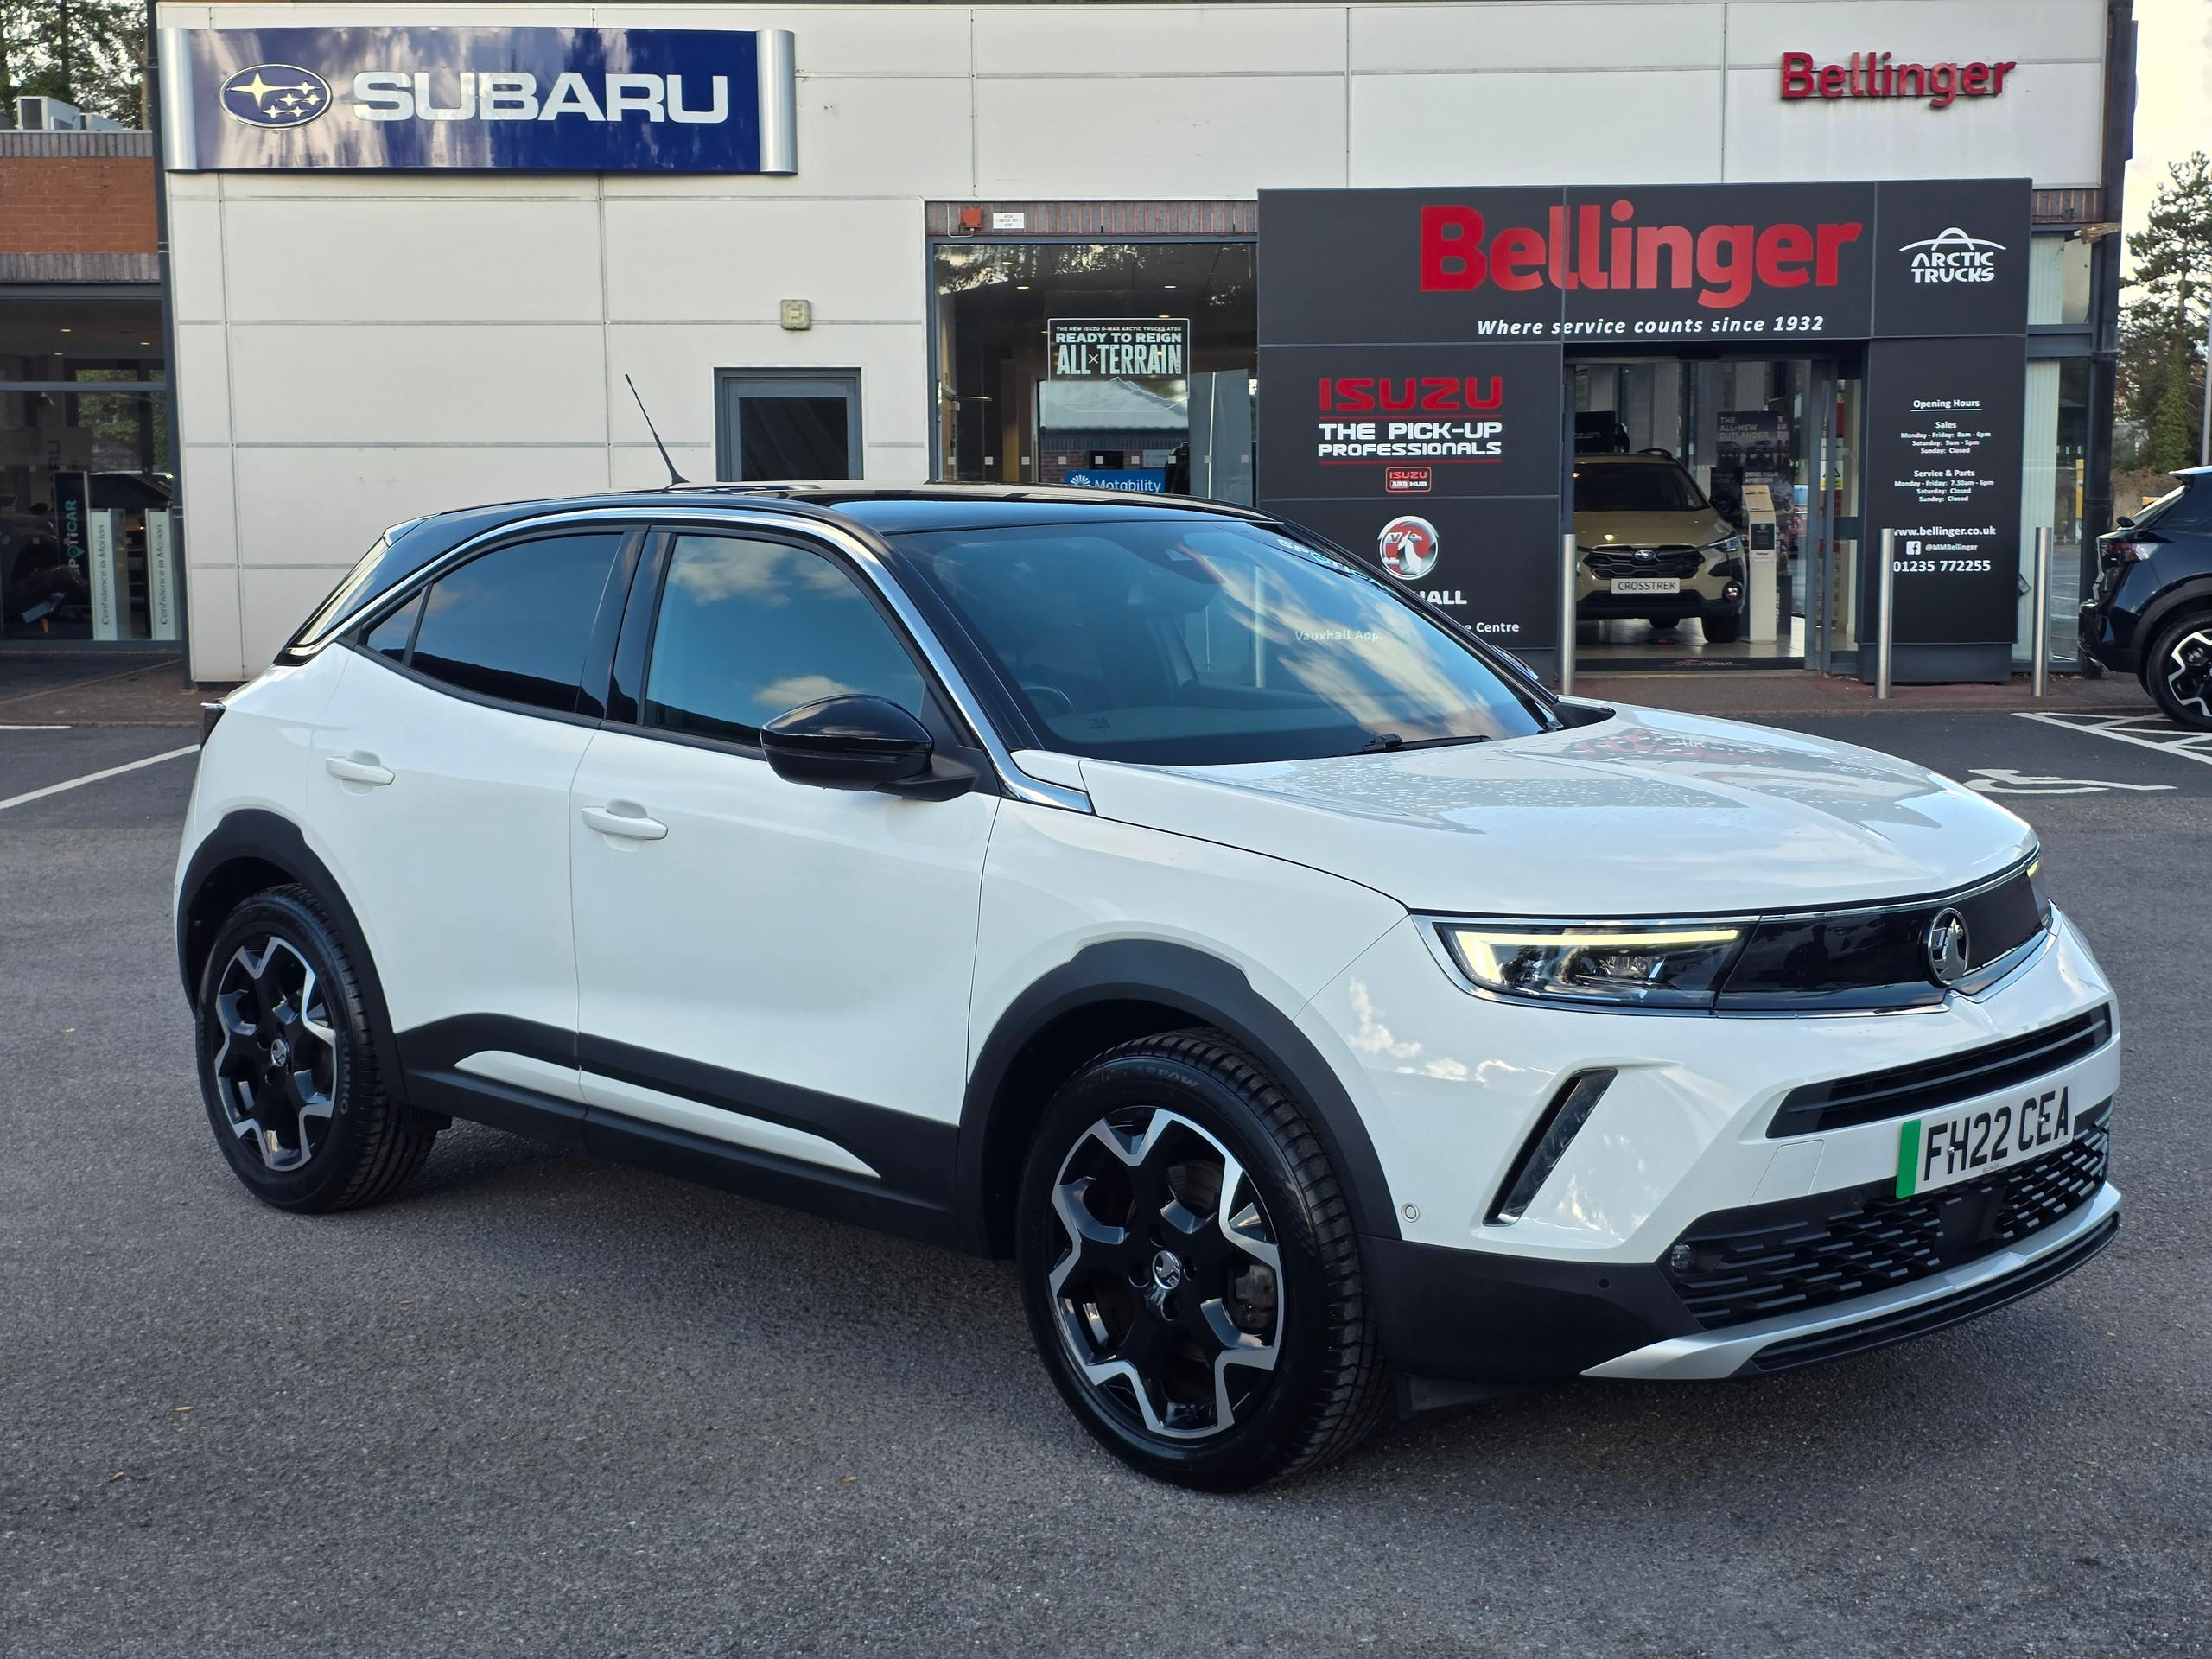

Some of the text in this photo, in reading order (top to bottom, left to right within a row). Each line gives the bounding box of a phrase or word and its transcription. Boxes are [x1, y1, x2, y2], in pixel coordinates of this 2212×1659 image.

[1781, 51, 2018, 107] Bellinger
[353, 71, 728, 124] SUBARU
[1420, 200, 1863, 308] Bellinger
[1911, 251, 1994, 267] ARCTIC
[1910, 267, 1995, 283] TRUCKS
[1477, 315, 1825, 335] Where service counts since 1932
[1055, 332, 1182, 343] READY TO REIGN
[1318, 376, 1503, 412] ISUZU
[1913, 399, 1980, 409] Opening Hours
[1318, 421, 1503, 441] THE PICK-UP
[1318, 442, 1502, 457] PROFESSIONALS
[1944, 469, 1953, 478] &
[1954, 469, 1975, 478] Parts
[1094, 479, 1161, 493] Motability
[1924, 543, 1979, 552] @MMBellinger
[1893, 560, 1992, 572] 01235 772255
[1618, 582, 1676, 591] CROSSTREK
[1476, 621, 1520, 633] Centre
[1294, 629, 1383, 644] Vauxhall App.
[1923, 1085, 2069, 1181] FH22 CEA
